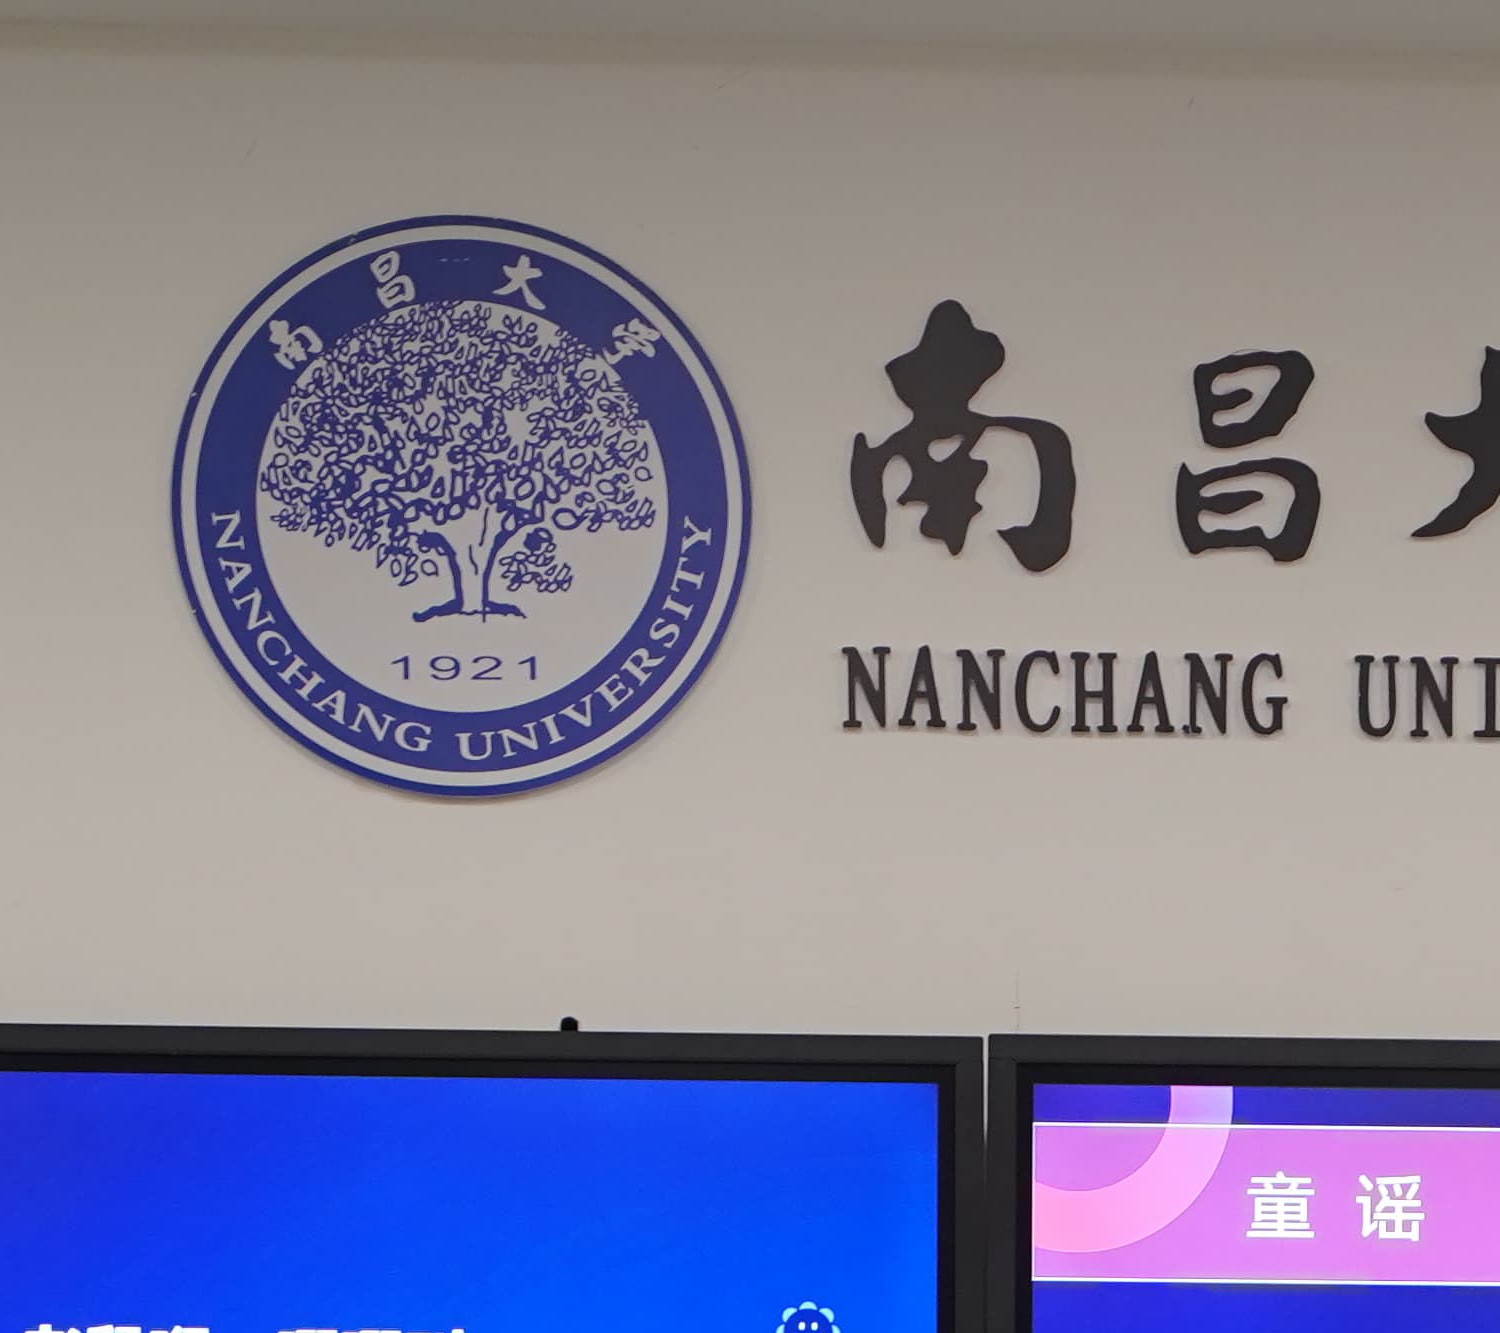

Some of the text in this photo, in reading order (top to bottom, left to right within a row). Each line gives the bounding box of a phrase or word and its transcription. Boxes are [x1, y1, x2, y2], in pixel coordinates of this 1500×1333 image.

[210, 509, 714, 762] NANCHANG UNIVERSITY
[390, 655, 538, 681] 1921
[841, 645, 1288, 736] NANCHANG
